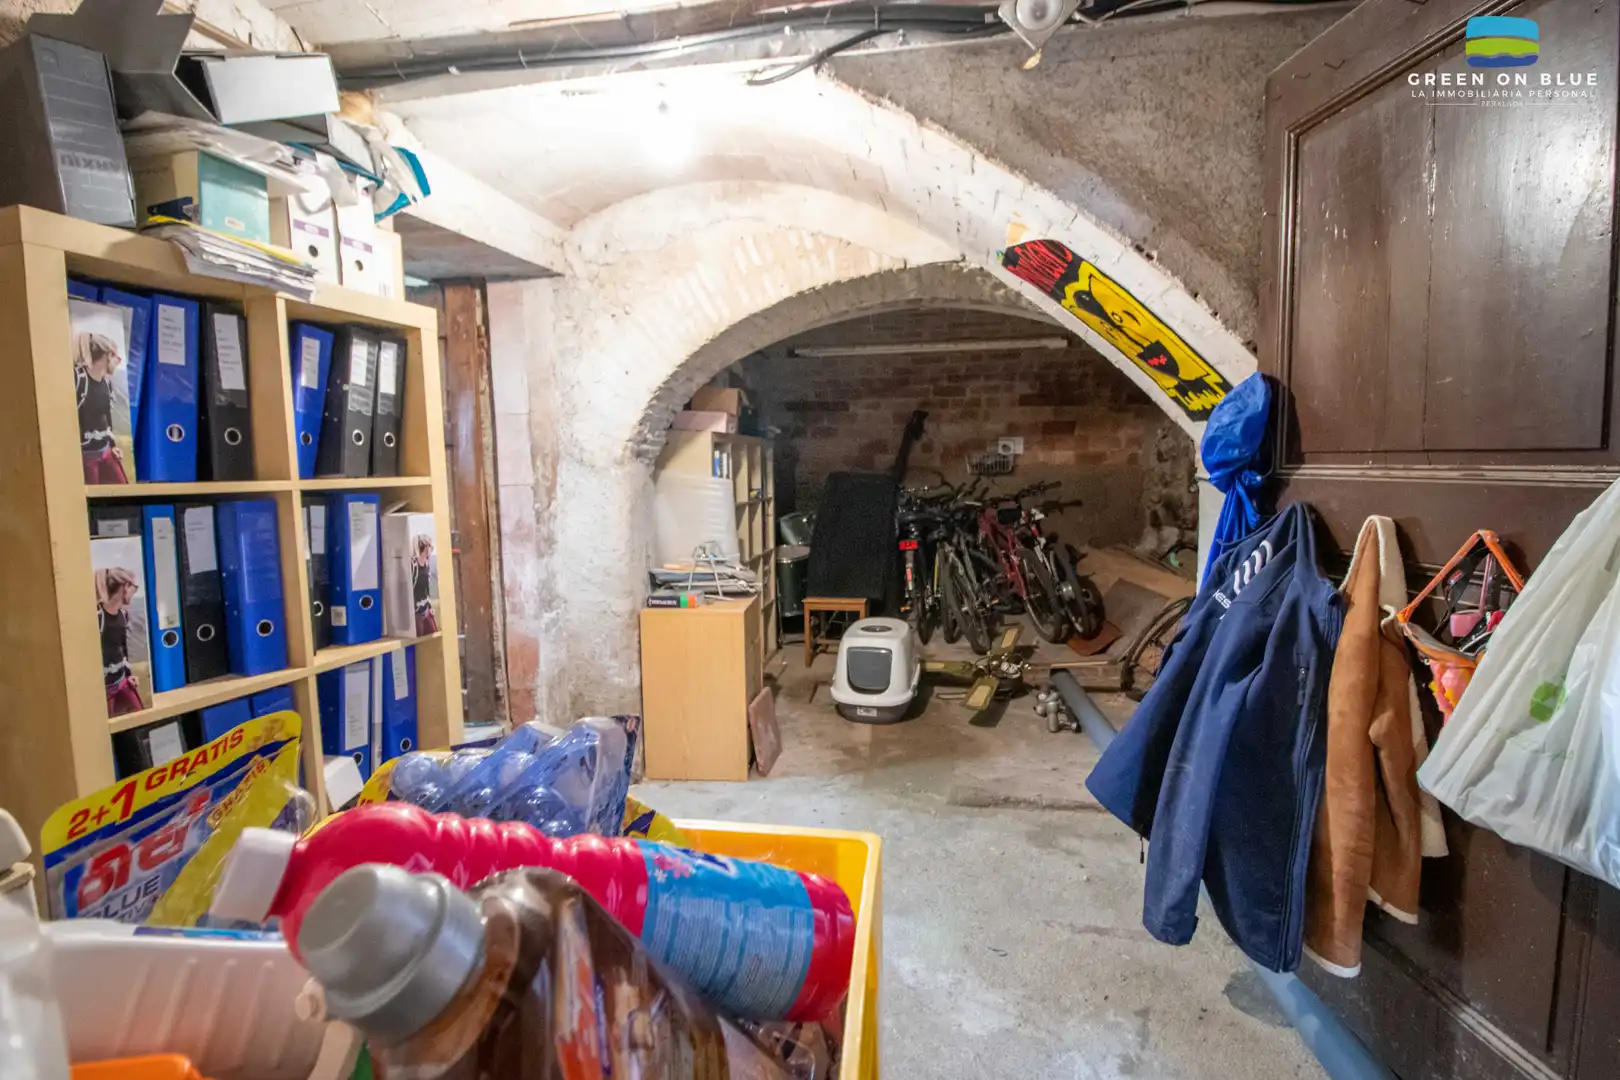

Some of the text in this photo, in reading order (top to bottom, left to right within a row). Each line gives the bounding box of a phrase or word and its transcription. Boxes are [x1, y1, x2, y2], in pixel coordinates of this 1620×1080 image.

[66, 728, 244, 841] 2+1 GRATIS
[88, 875, 160, 918] LUE
